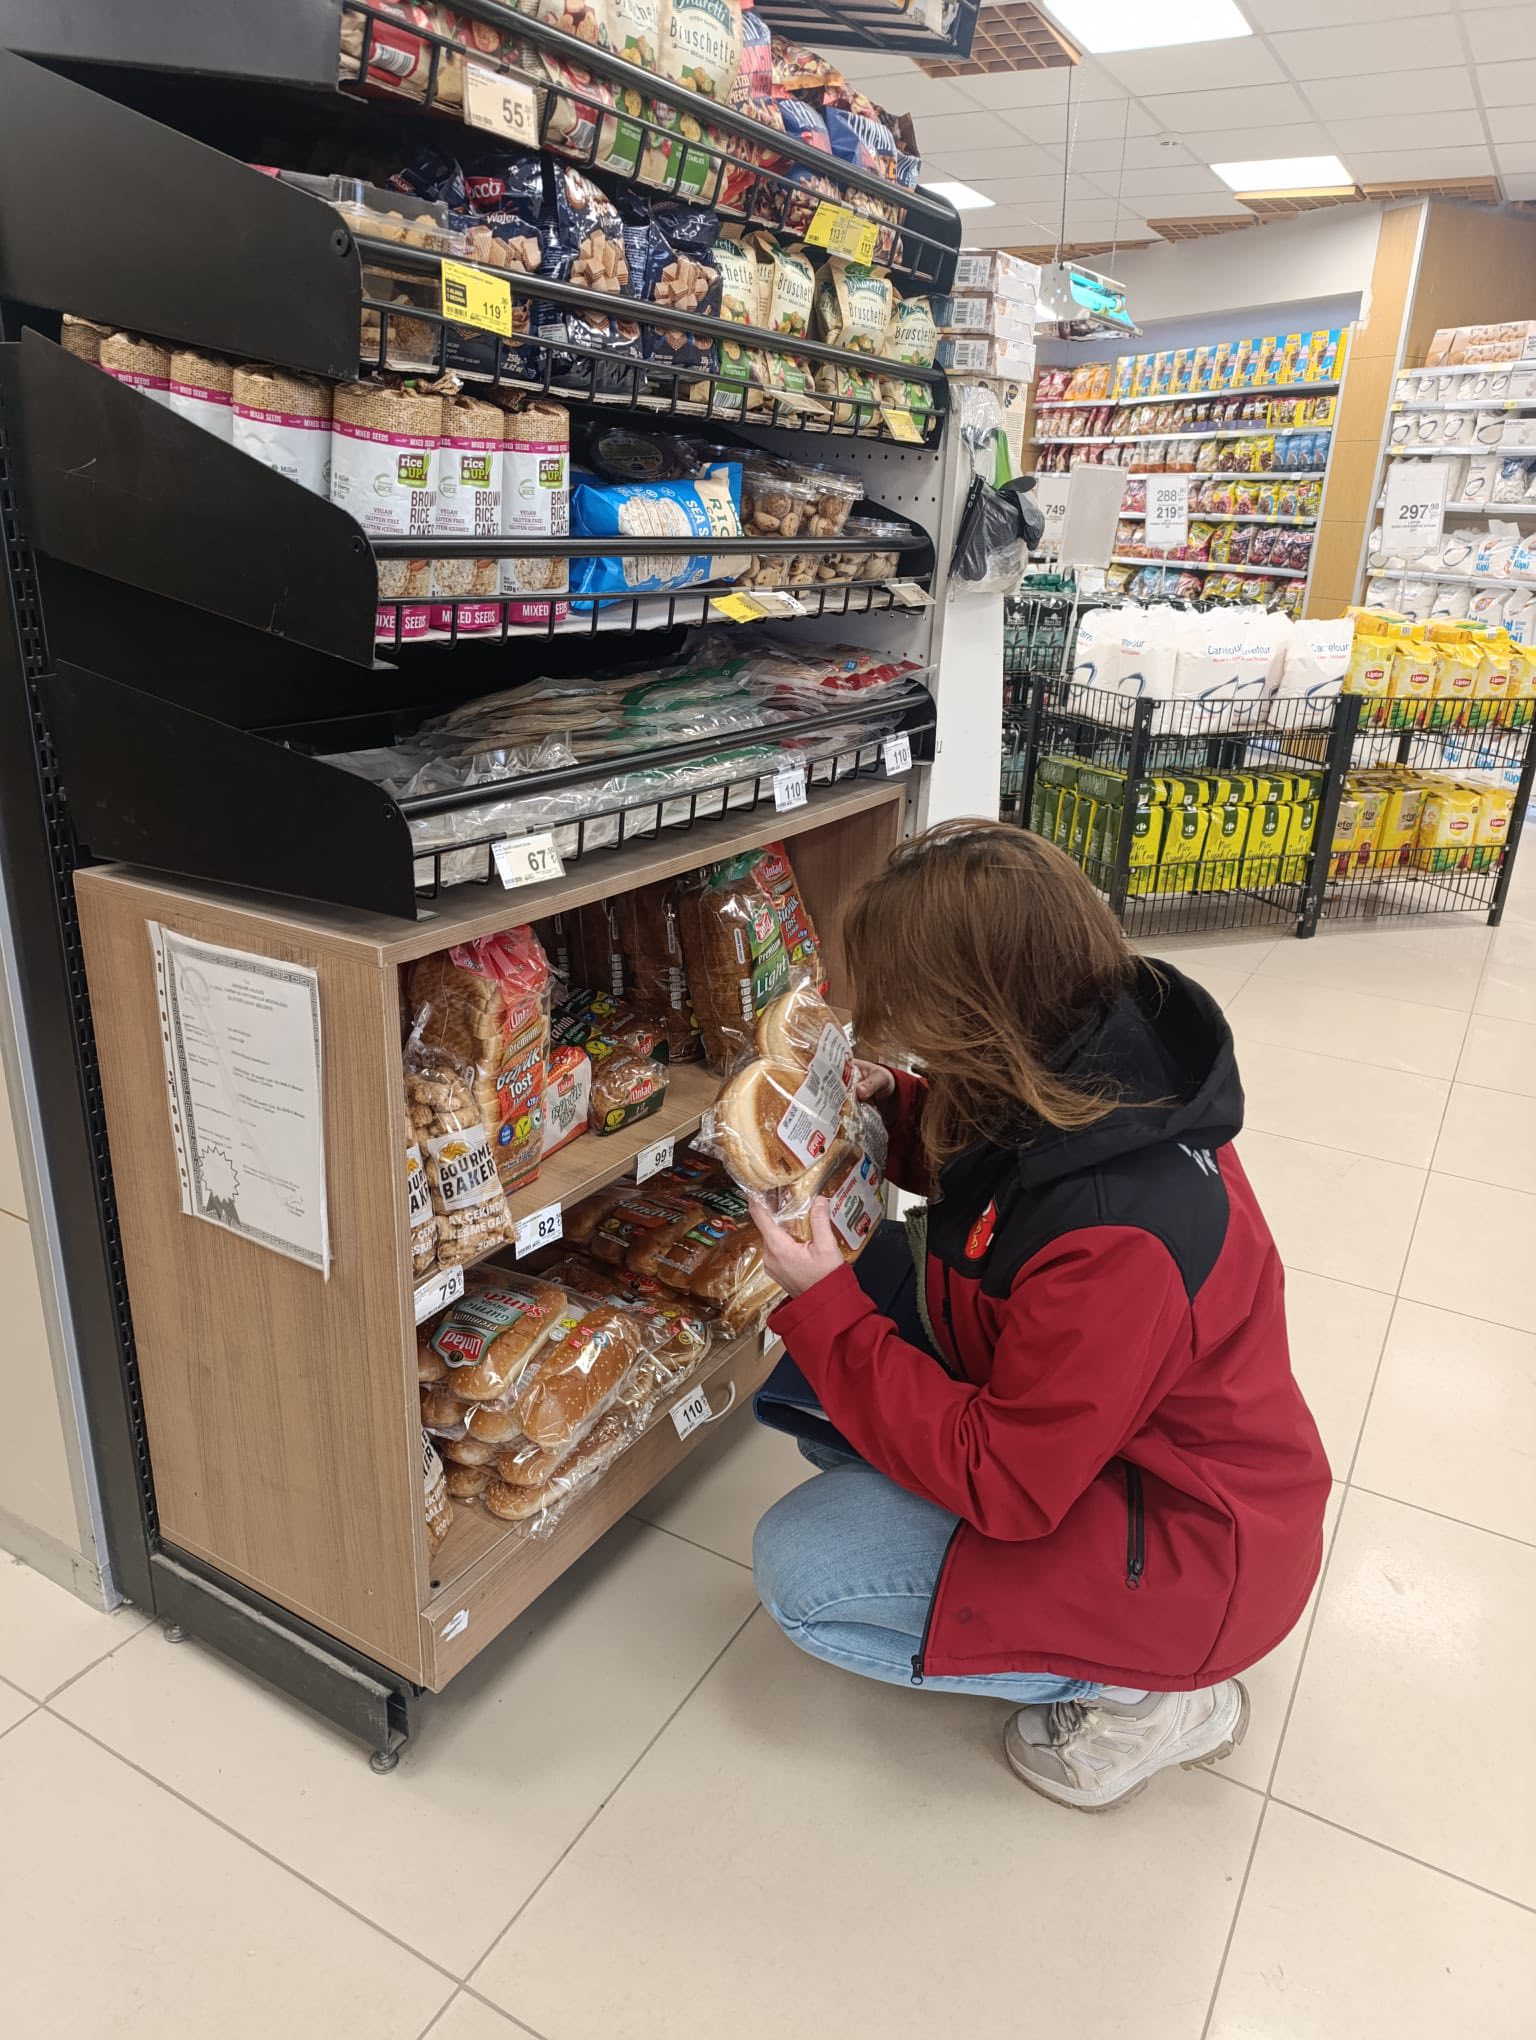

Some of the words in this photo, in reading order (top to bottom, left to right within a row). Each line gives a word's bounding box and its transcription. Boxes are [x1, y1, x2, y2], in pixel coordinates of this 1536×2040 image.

[669, 15, 736, 66] Bruschette
[502, 98, 524, 128] 55
[483, 302, 501, 319] 119
[849, 302, 887, 325] Bruschette
[355, 429, 371, 438] MIXED
[372, 432, 389, 442] SEEDS
[401, 455, 423, 468] rice
[463, 457, 485, 469] rice
[541, 460, 559, 470] rice
[1156, 489, 1177, 502] 288
[374, 507, 393, 515] VEGAN
[410, 507, 430, 524] RICE
[475, 507, 494, 522] RICE
[551, 505, 567, 520] RICE
[686, 500, 706, 524] SEA
[1045, 504, 1066, 516] 749
[1156, 506, 1177, 519] 219
[1399, 504, 1429, 519] 297
[475, 610, 496, 624] SEEDS
[522, 604, 549, 616] MIXED
[555, 602, 568, 616] EEDS
[405, 615, 426, 629] SEEDS
[1366, 671, 1384, 680] Lipton
[1490, 676, 1506, 684] Lipton
[893, 748, 908, 765] 110
[784, 781, 801, 800] 110
[1337, 820, 1353, 831] efor
[527, 849, 547, 872] 67
[756, 955, 788, 999] Light
[509, 1072, 533, 1099] Tost
[440, 1142, 492, 1181] GOURME
[655, 1148, 668, 1167] 99
[442, 1157, 496, 1201] BAKER
[538, 1216, 556, 1237] 82
[440, 1279, 457, 1301] 79
[463, 1301, 510, 1322] Gurme
[453, 1312, 499, 1332] Premium
[442, 1331, 482, 1356] Untad
[683, 1399, 703, 1423] 110
